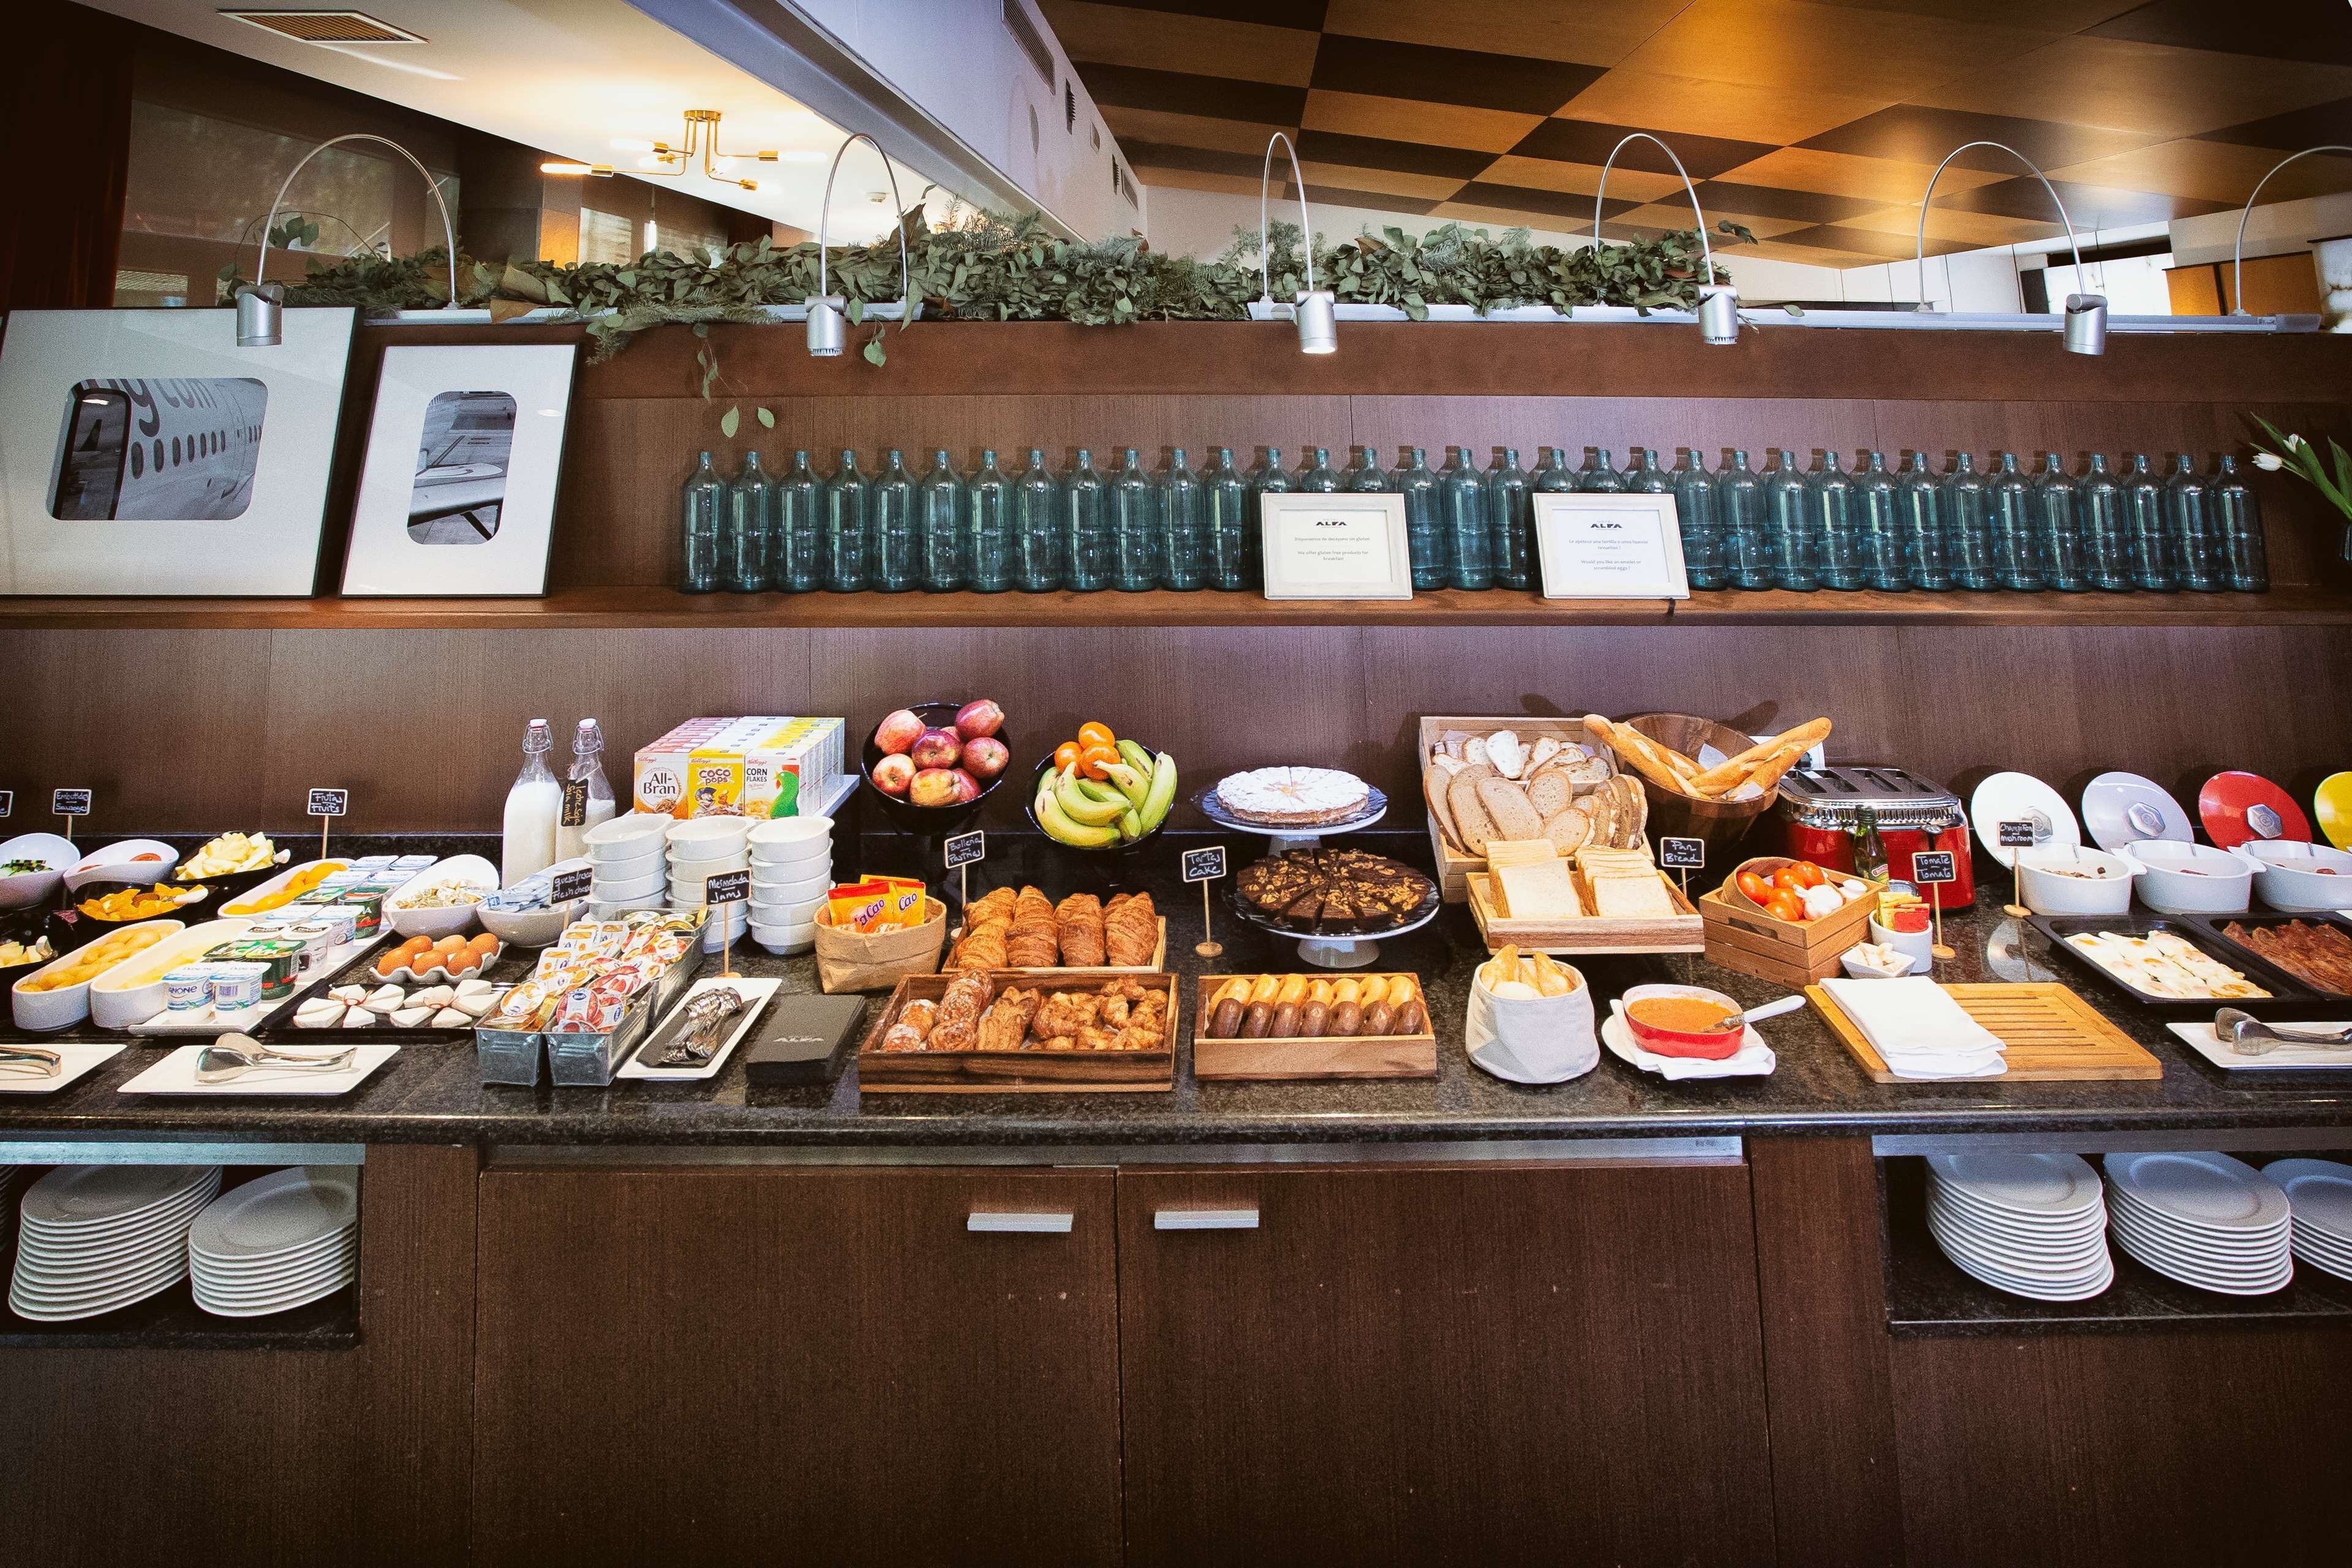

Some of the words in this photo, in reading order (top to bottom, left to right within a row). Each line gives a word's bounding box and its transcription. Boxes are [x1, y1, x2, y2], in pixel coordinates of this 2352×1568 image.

[650, 772, 673, 785] All-
[705, 777, 728, 785] pops
[644, 782, 676, 794] Bran
[312, 792, 343, 803] Frutas
[311, 803, 340, 813] Fruits
[1670, 840, 1697, 851] Pan
[948, 850, 981, 864] Pastries
[1187, 851, 1221, 864] Tartas
[1665, 853, 1702, 862] Bread
[1916, 854, 1950, 865] Tomate
[1917, 867, 1951, 879] Tomato
[710, 890, 741, 903] Jams
[899, 892, 918, 912] Cao
